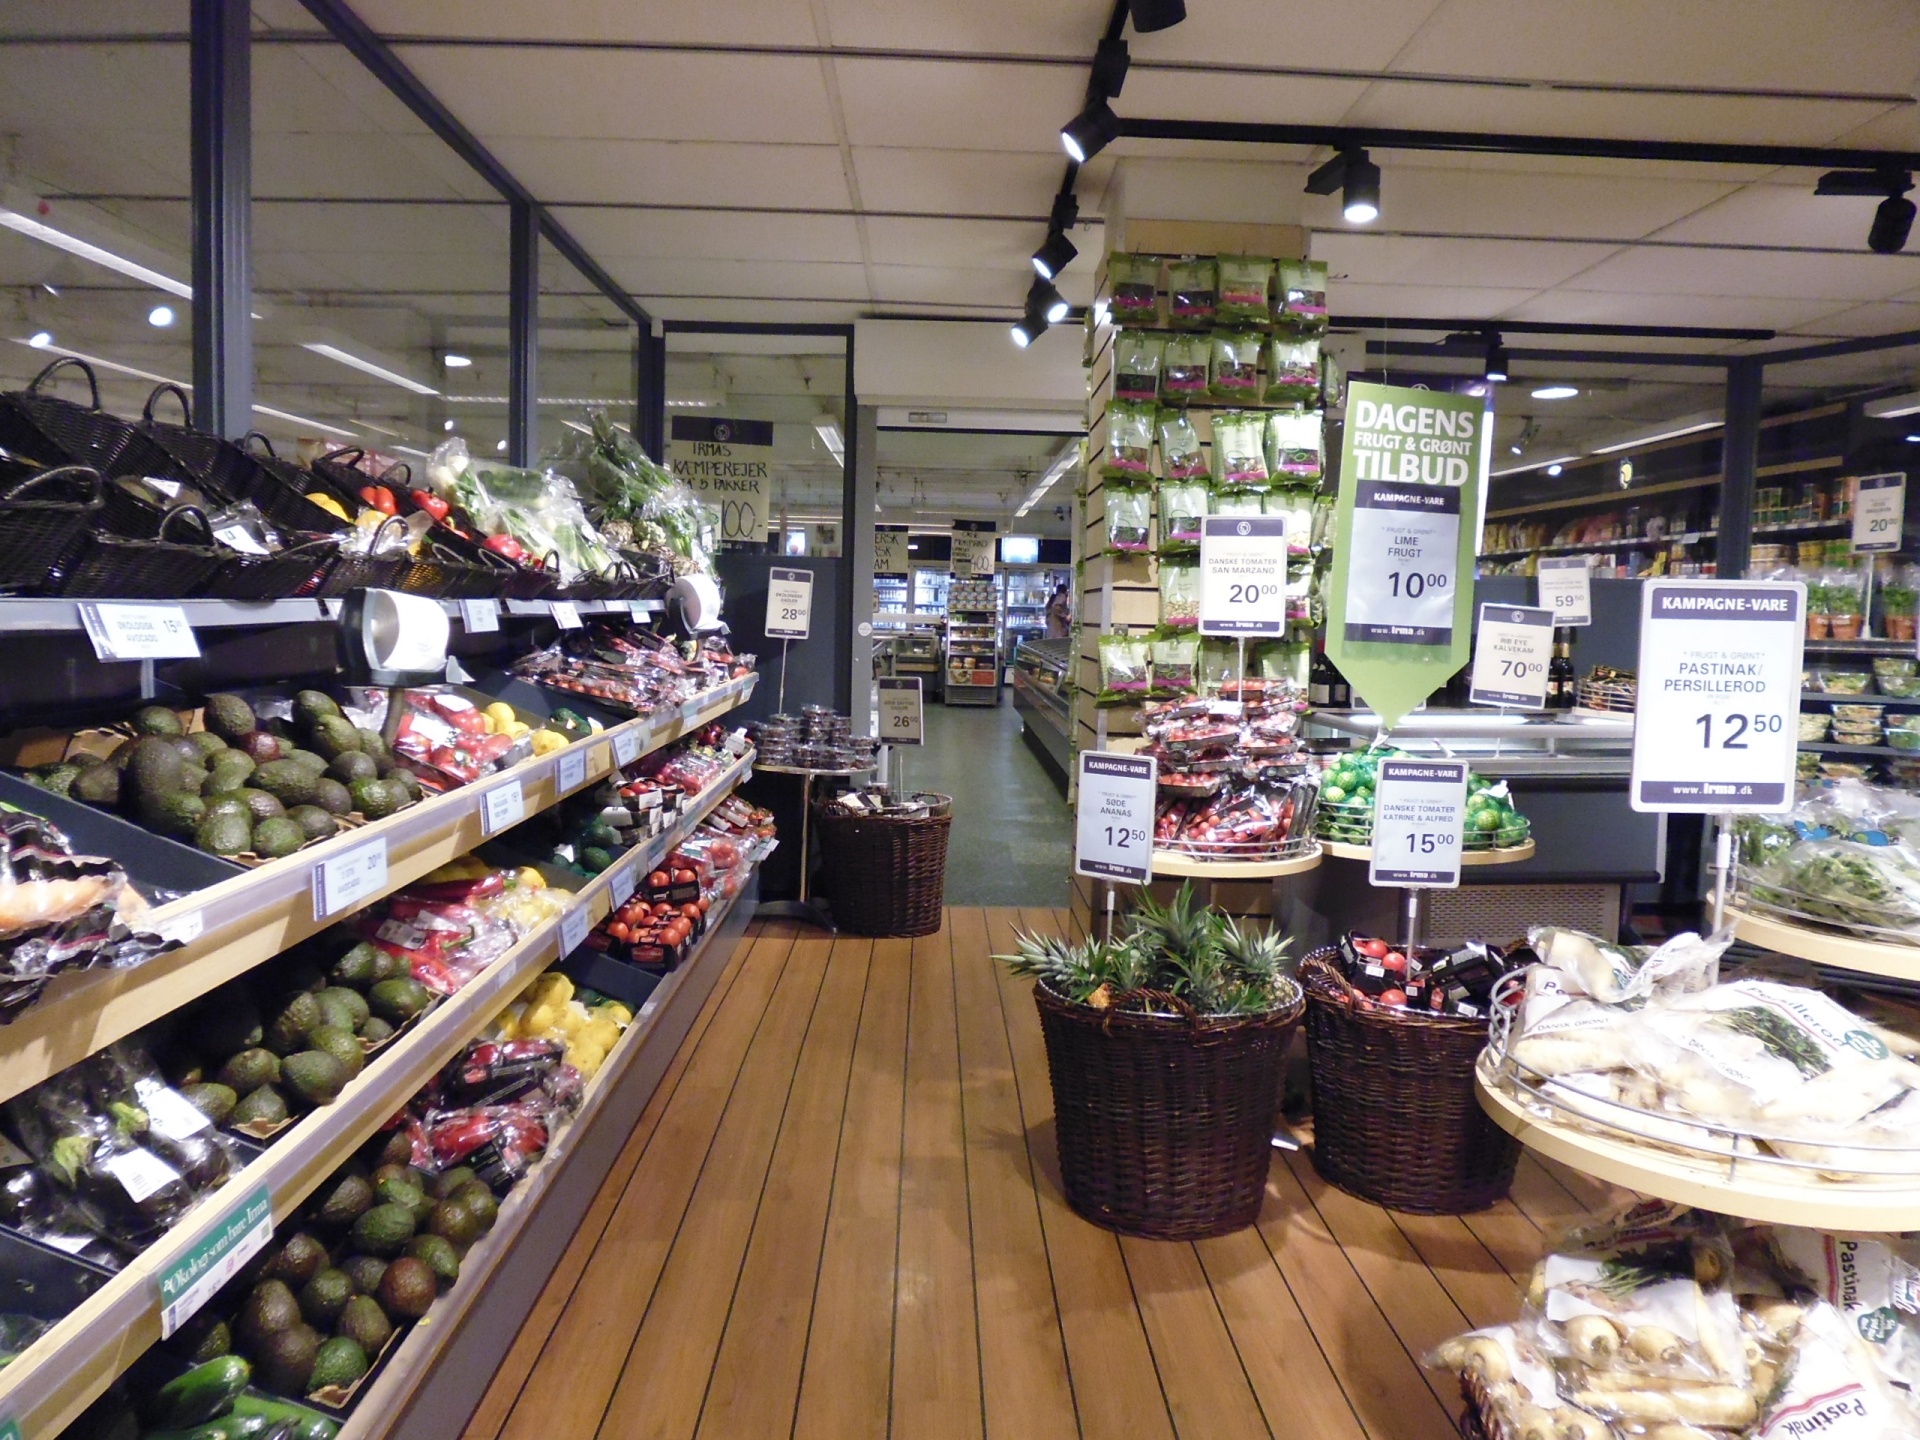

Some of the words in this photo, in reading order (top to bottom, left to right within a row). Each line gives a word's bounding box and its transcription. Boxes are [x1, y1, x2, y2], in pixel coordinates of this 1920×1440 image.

[1355, 401, 1474, 438] DAGENS
[693, 442, 731, 457] IRMAS
[1354, 431, 1402, 449] FRUGT
[1405, 437, 1416, 451] &
[1420, 438, 1472, 456] GRØNT
[673, 459, 767, 478] KÆMPEREJER
[1352, 449, 1469, 486] TILBUD
[699, 478, 709, 490] 5
[714, 478, 760, 494] PAKKER
[1374, 492, 1445, 506] KAMPAGNE-VARE
[1394, 536, 1419, 546] LIME
[1387, 547, 1422, 558] FRUGT
[1212, 566, 1230, 574] SAN
[1232, 566, 1275, 575] MARZANO
[1662, 596, 1789, 612] KAMPAGNE-VARE
[1493, 645, 1534, 654] KALVEKAM
[1690, 651, 1720, 659] FRUGT
[1721, 651, 1728, 659] &
[1664, 679, 1766, 693] PERSILLEROD
[1088, 761, 1148, 775] KAMPAGNE-VARE
[1388, 768, 1458, 778] KAMPAGNE-VARE
[1105, 798, 1126, 807] SØDE
[1383, 804, 1415, 812] DANSKE
[1418, 805, 1455, 813] TOMATER
[1100, 806, 1132, 818] ANANAS
[1537, 1022, 1570, 1031] DANSK
[1839, 1241, 1863, 1312] Pastinak
[1781, 1398, 1869, 1440] Pastinak
